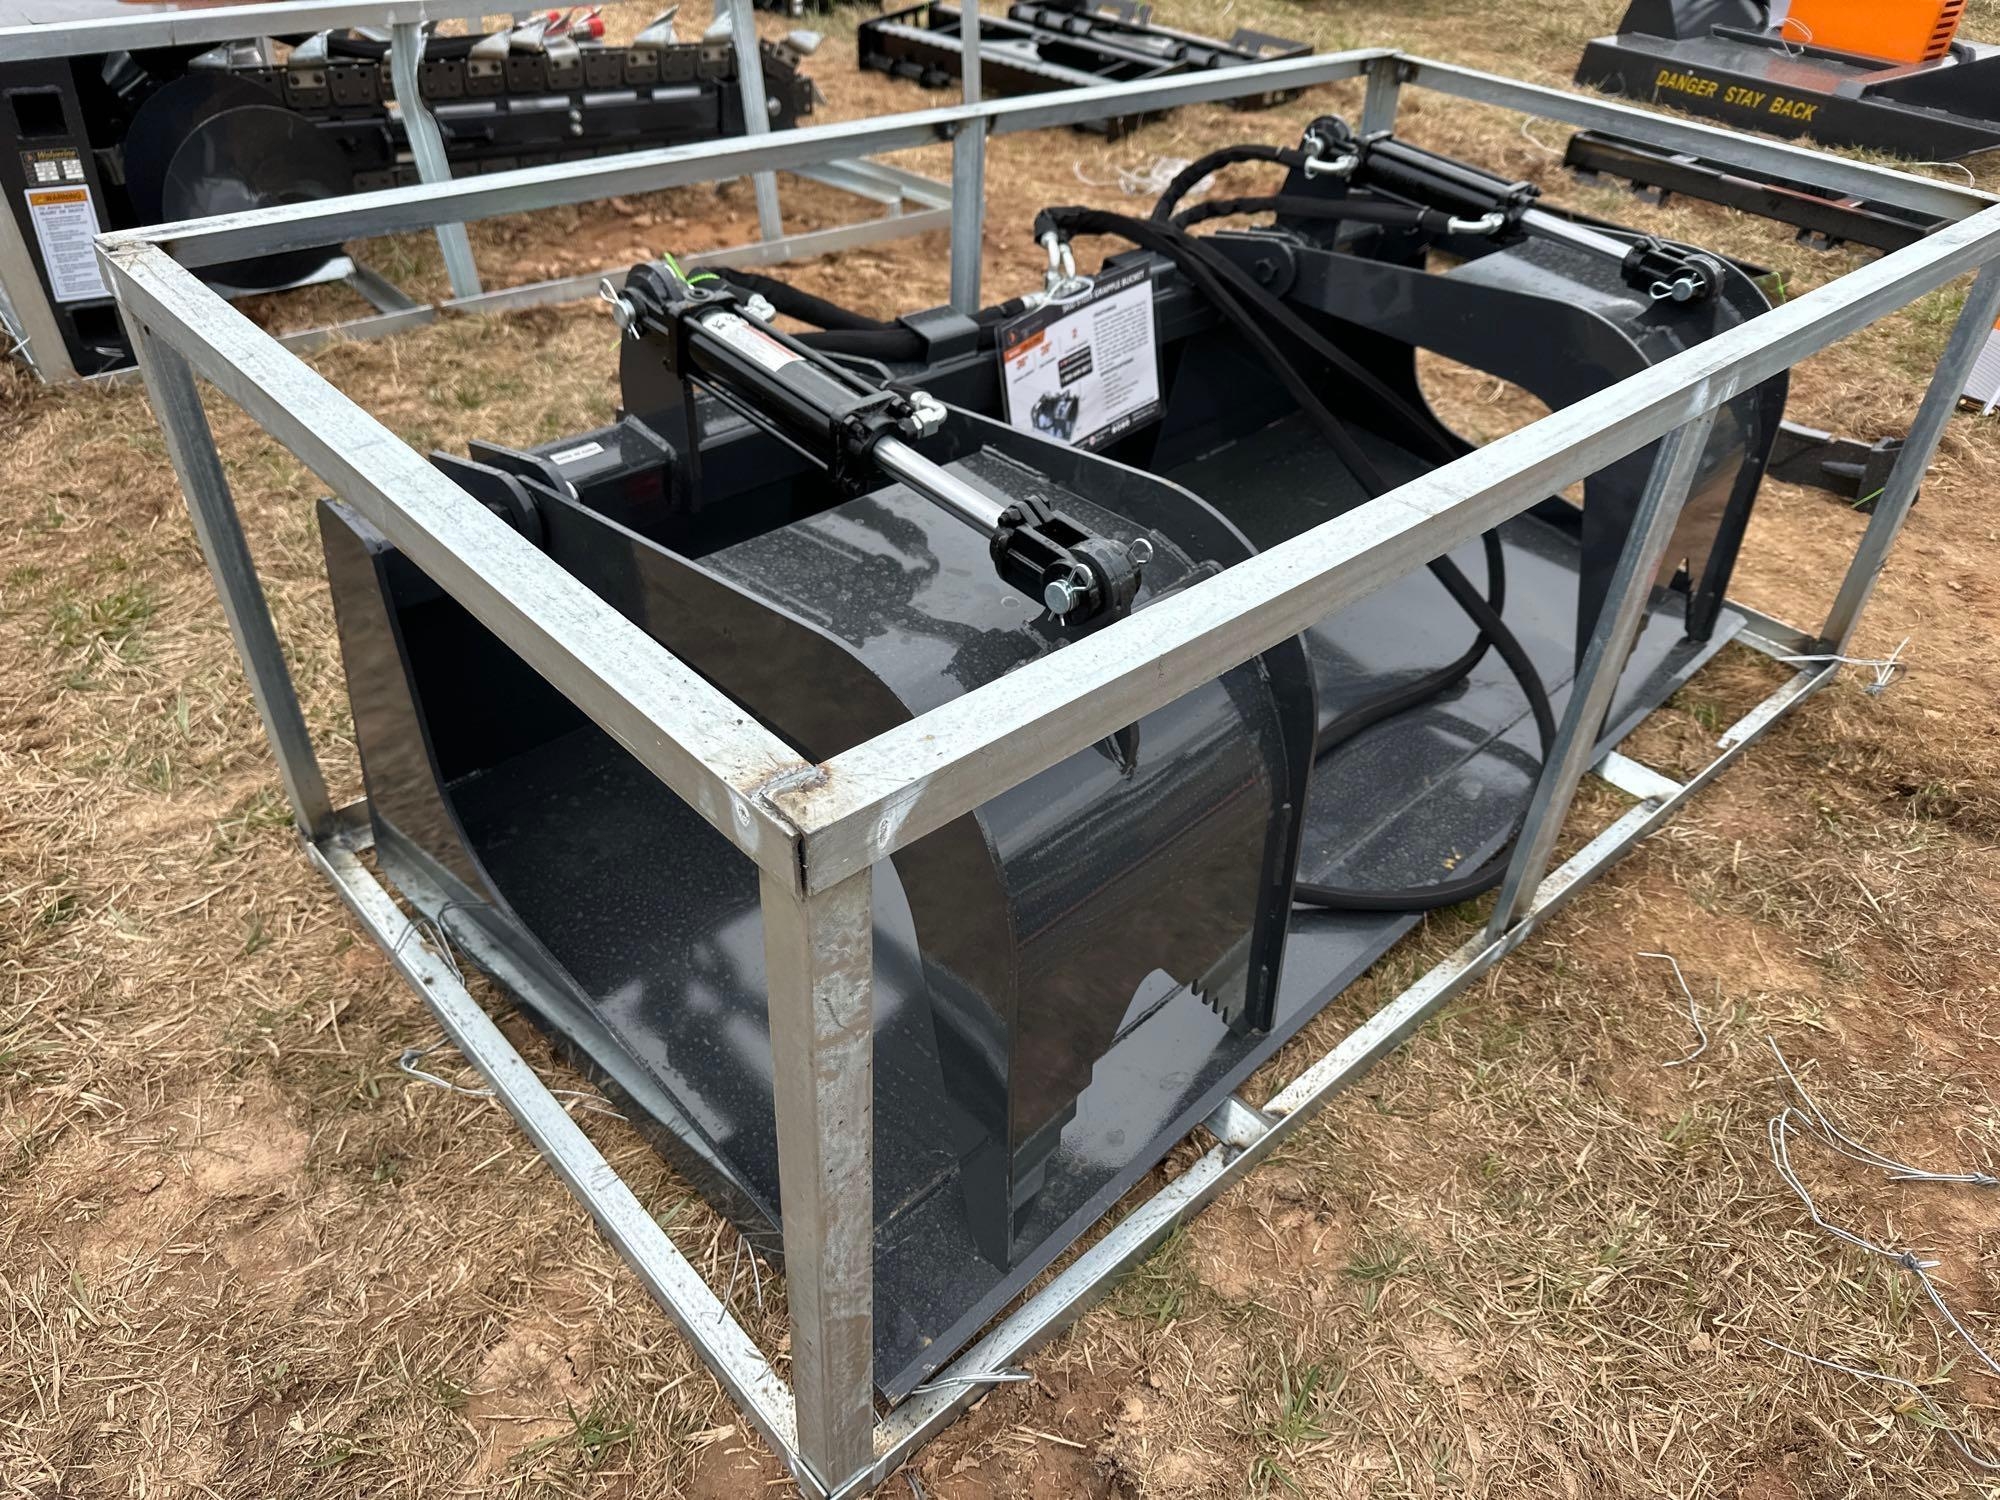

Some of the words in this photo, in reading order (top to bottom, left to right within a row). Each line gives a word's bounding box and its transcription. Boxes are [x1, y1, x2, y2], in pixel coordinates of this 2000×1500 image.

[1655, 70, 1718, 98] DANGER
[1724, 86, 1766, 108] STAY
[1768, 97, 1818, 121] BACK
[1122, 269, 1145, 287] BUCKET
